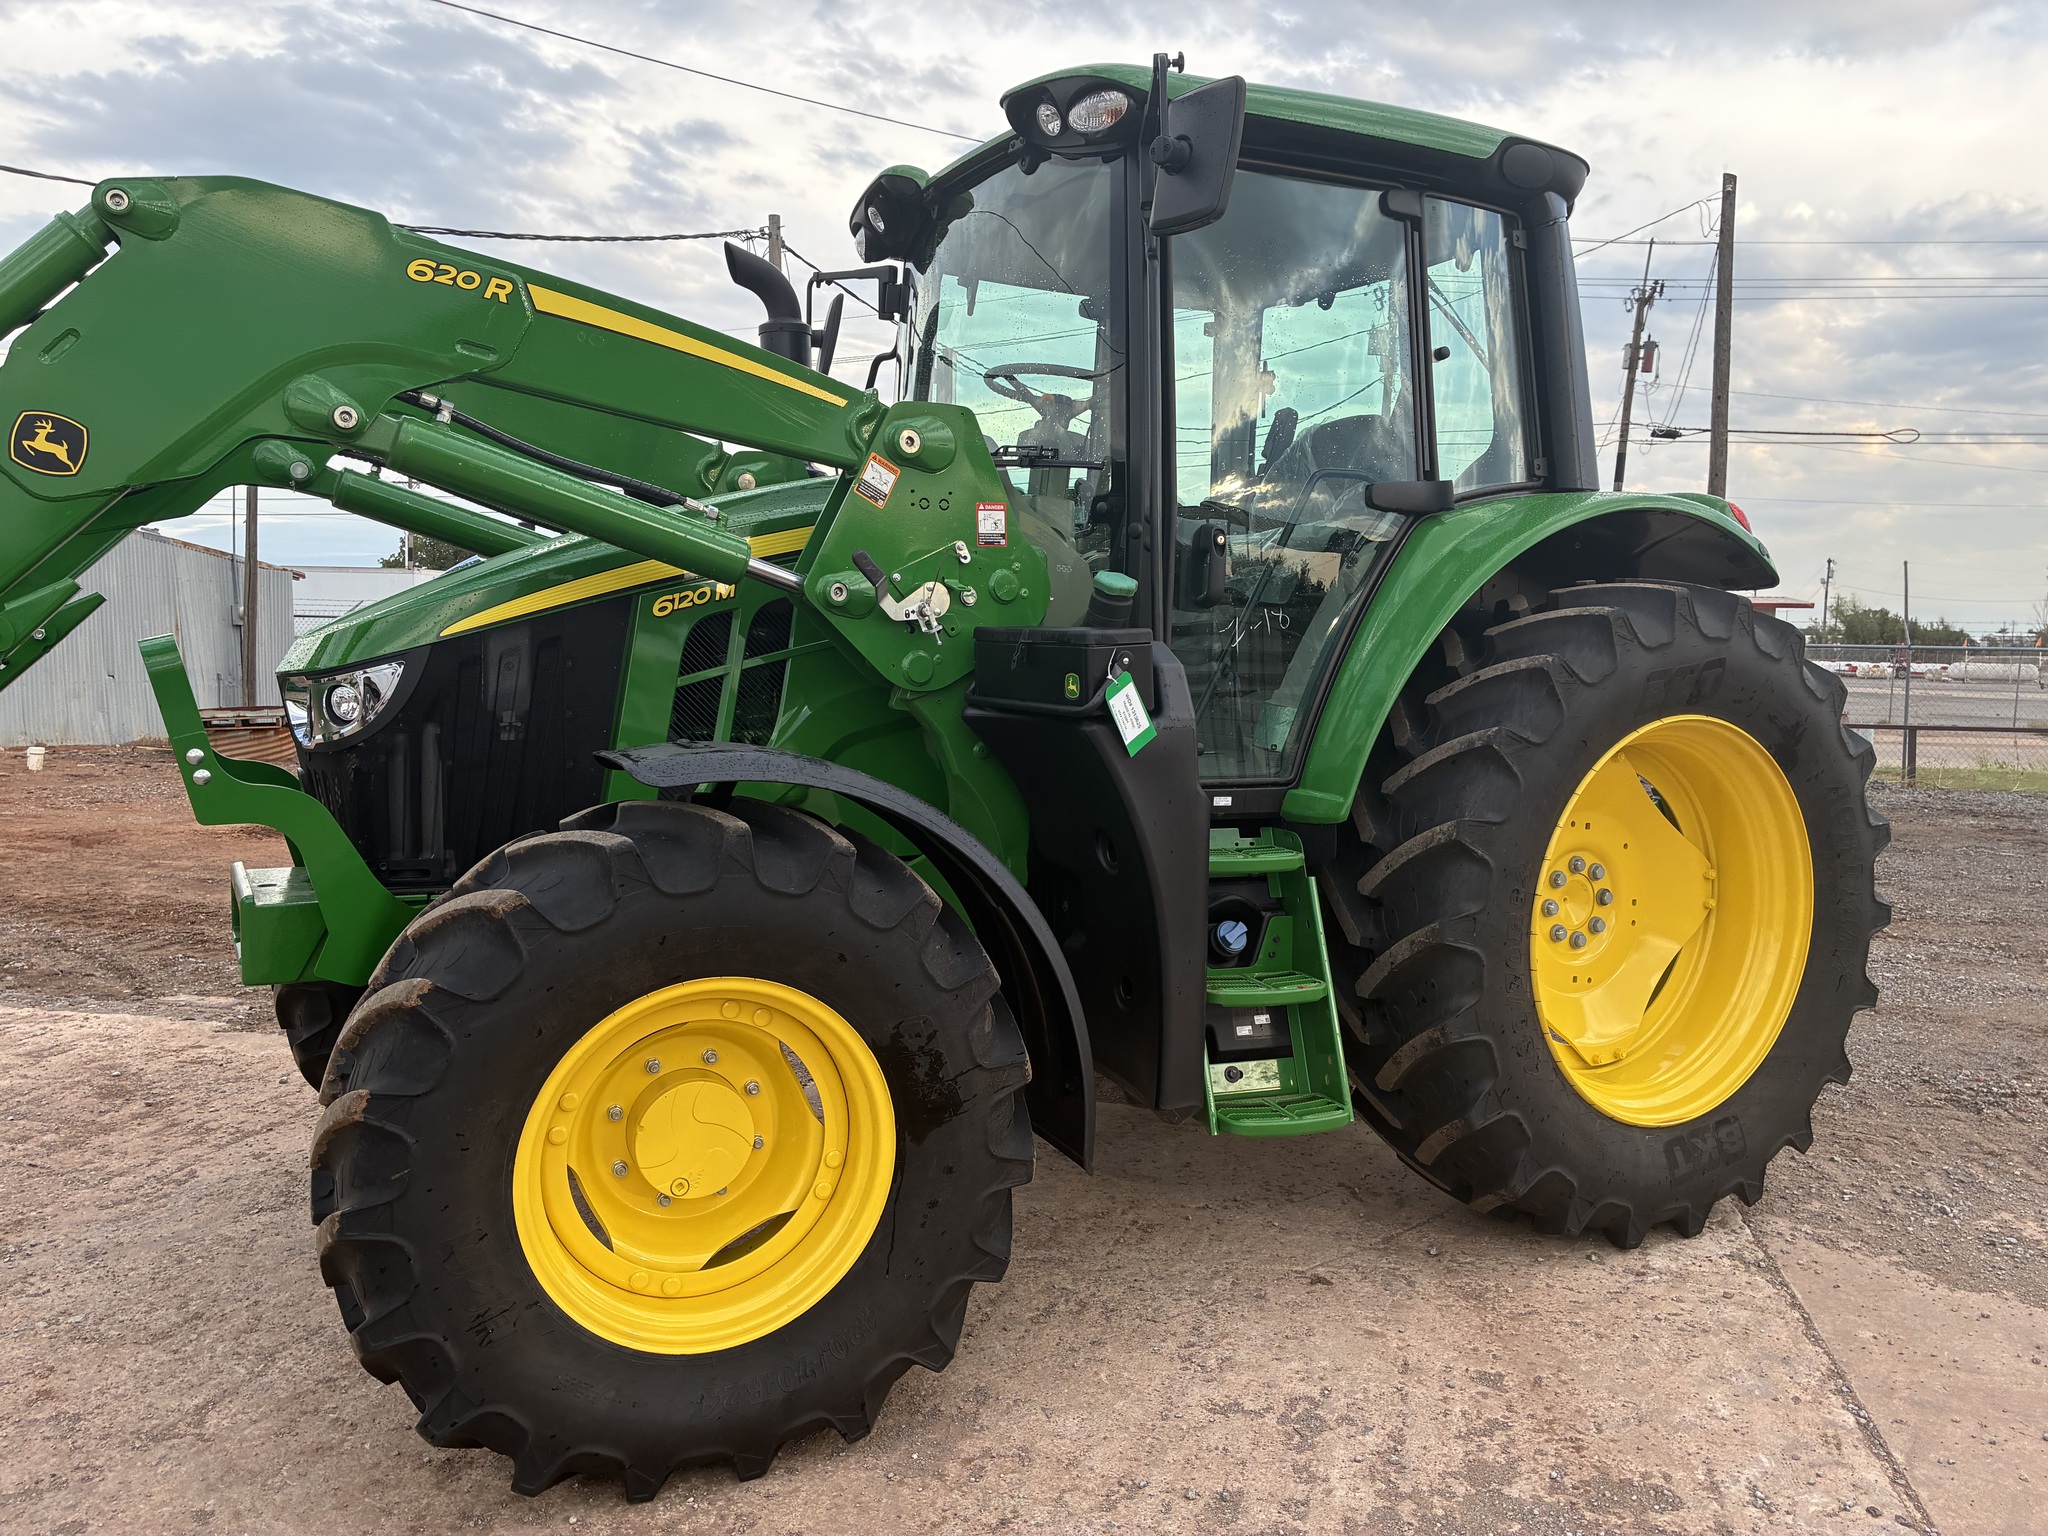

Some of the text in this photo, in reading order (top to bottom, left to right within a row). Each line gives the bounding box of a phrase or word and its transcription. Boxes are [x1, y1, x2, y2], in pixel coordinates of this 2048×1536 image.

[406, 258, 515, 305] 620 R
[877, 458, 898, 475] WARNING
[652, 582, 737, 619] 6120 M
[1662, 1116, 1747, 1182] BKT
